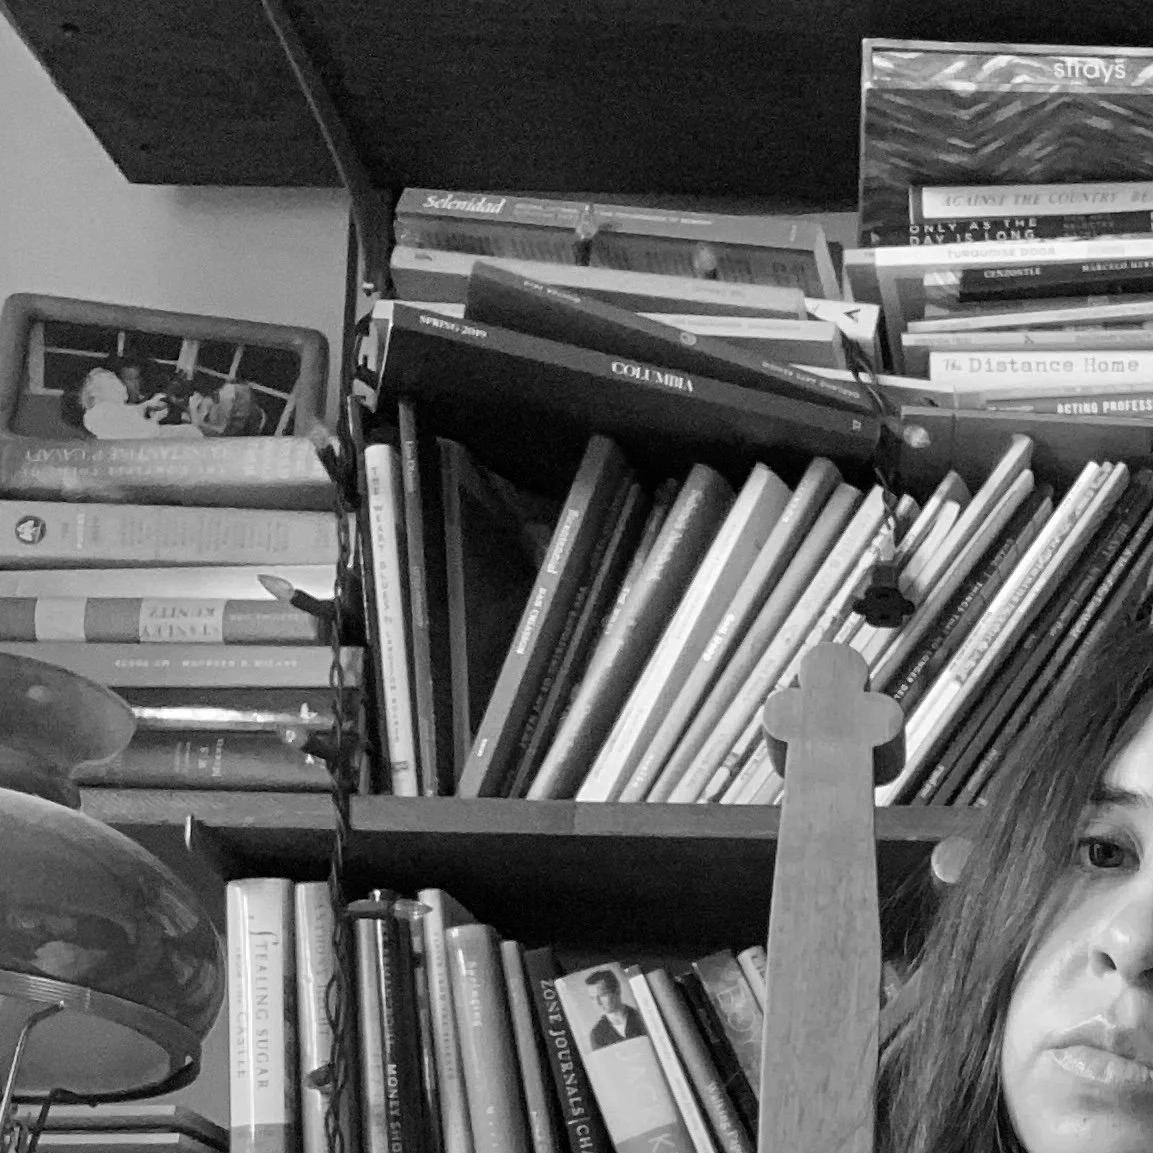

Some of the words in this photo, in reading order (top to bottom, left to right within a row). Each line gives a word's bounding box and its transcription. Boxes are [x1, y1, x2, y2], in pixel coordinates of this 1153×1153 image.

[1053, 60, 1126, 82] strays
[943, 194, 1005, 207] AGAINST
[1013, 193, 1039, 204] THE
[1048, 190, 1118, 203] COUNTRY
[909, 222, 957, 233] ONLY
[969, 221, 990, 229] AS
[1004, 218, 1036, 227] THE
[909, 234, 944, 245] DAY
[956, 233, 973, 242] IS
[984, 229, 1034, 240] LONG
[612, 360, 697, 392] COLUMBIA
[968, 356, 1073, 372] Distance
[1083, 356, 1139, 372] Home
[1055, 401, 1098, 415] ACTING
[248, 930, 281, 1021] STEALING
[540, 979, 562, 1025] ZONE
[236, 1008, 251, 1078] CASTLE
[255, 1028, 269, 1088] SUGAR
[386, 1061, 400, 1115] MONEY
[548, 1029, 585, 1117] JOURNALS
